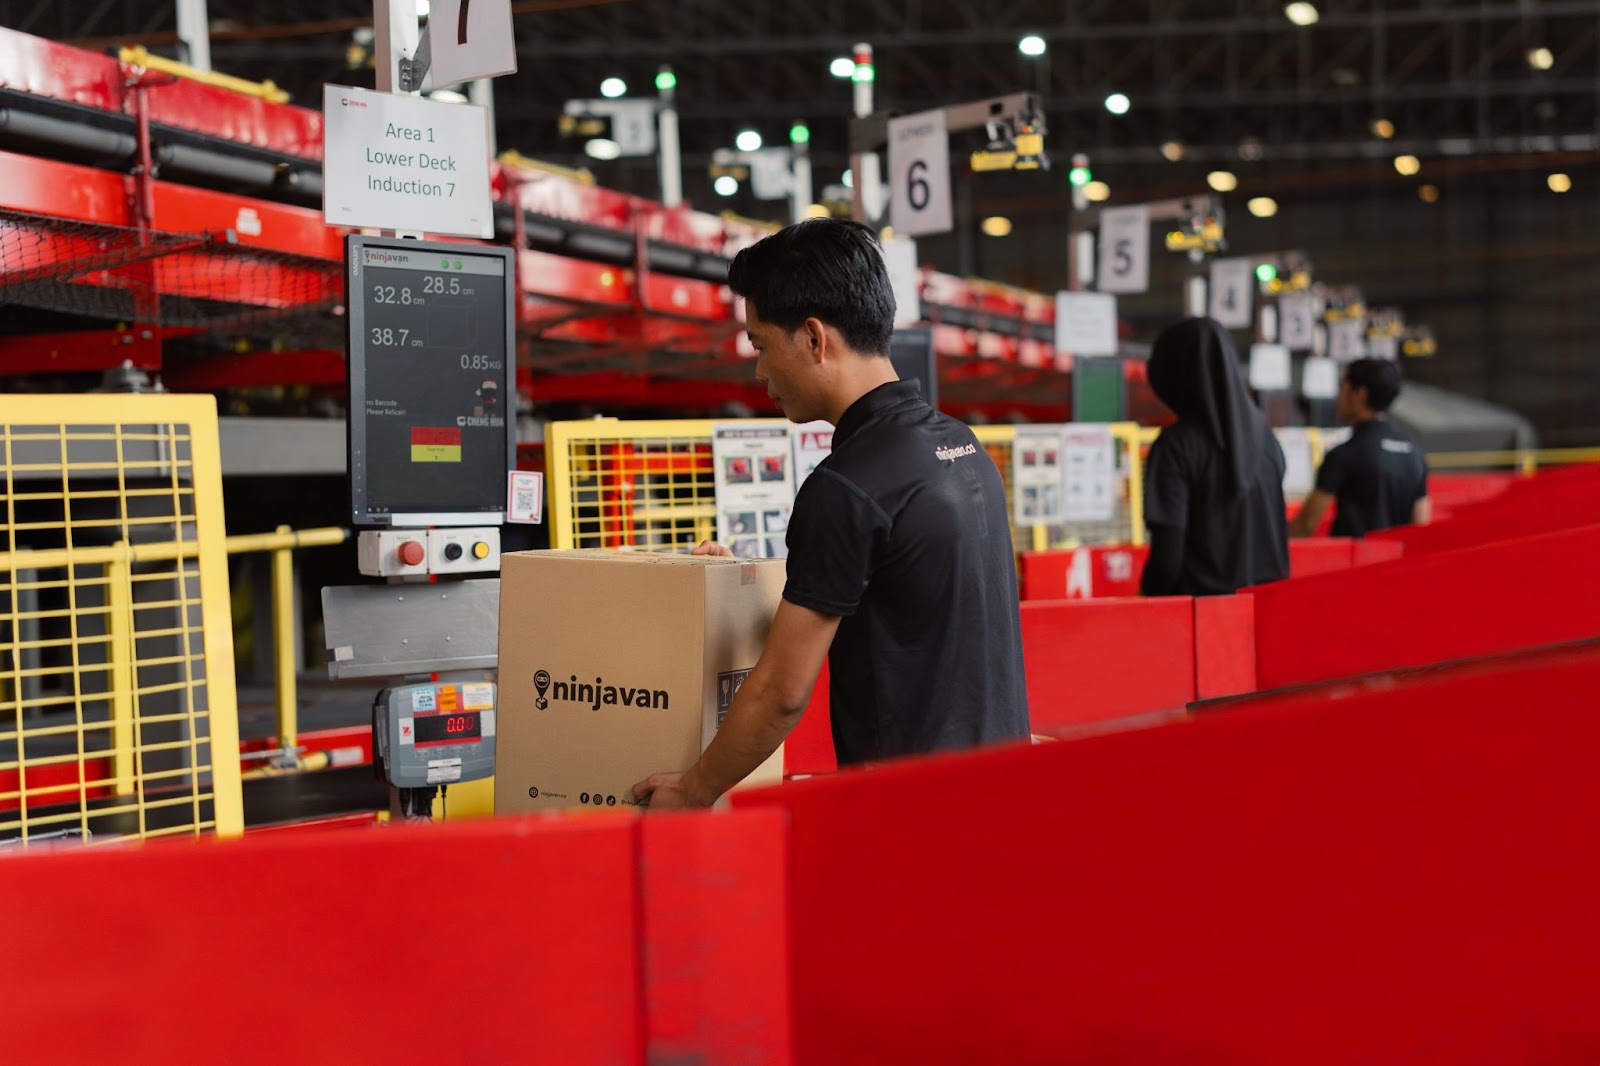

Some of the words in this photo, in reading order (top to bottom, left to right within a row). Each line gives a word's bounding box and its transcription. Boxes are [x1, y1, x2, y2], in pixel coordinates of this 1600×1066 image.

[385, 122, 421, 141] Area
[427, 127, 436, 143] 1
[366, 147, 414, 167] Lower
[419, 153, 456, 172] Deck
[368, 174, 442, 197] Induction
[447, 182, 456, 198] 7
[908, 160, 930, 211] 6
[370, 250, 409, 264] ninjavan
[1113, 239, 1133, 277] 5
[374, 285, 412, 305] 32.8
[413, 297, 425, 306] cm
[423, 276, 460, 295] 28.5
[463, 287, 474, 296] cm
[371, 327, 409, 347] 38.7
[411, 339, 423, 348] cm
[467, 416, 489, 427] CHENG
[490, 417, 504, 427] HUA
[552, 675, 669, 712] ninjavan
[446, 716, 475, 733] 0.00
